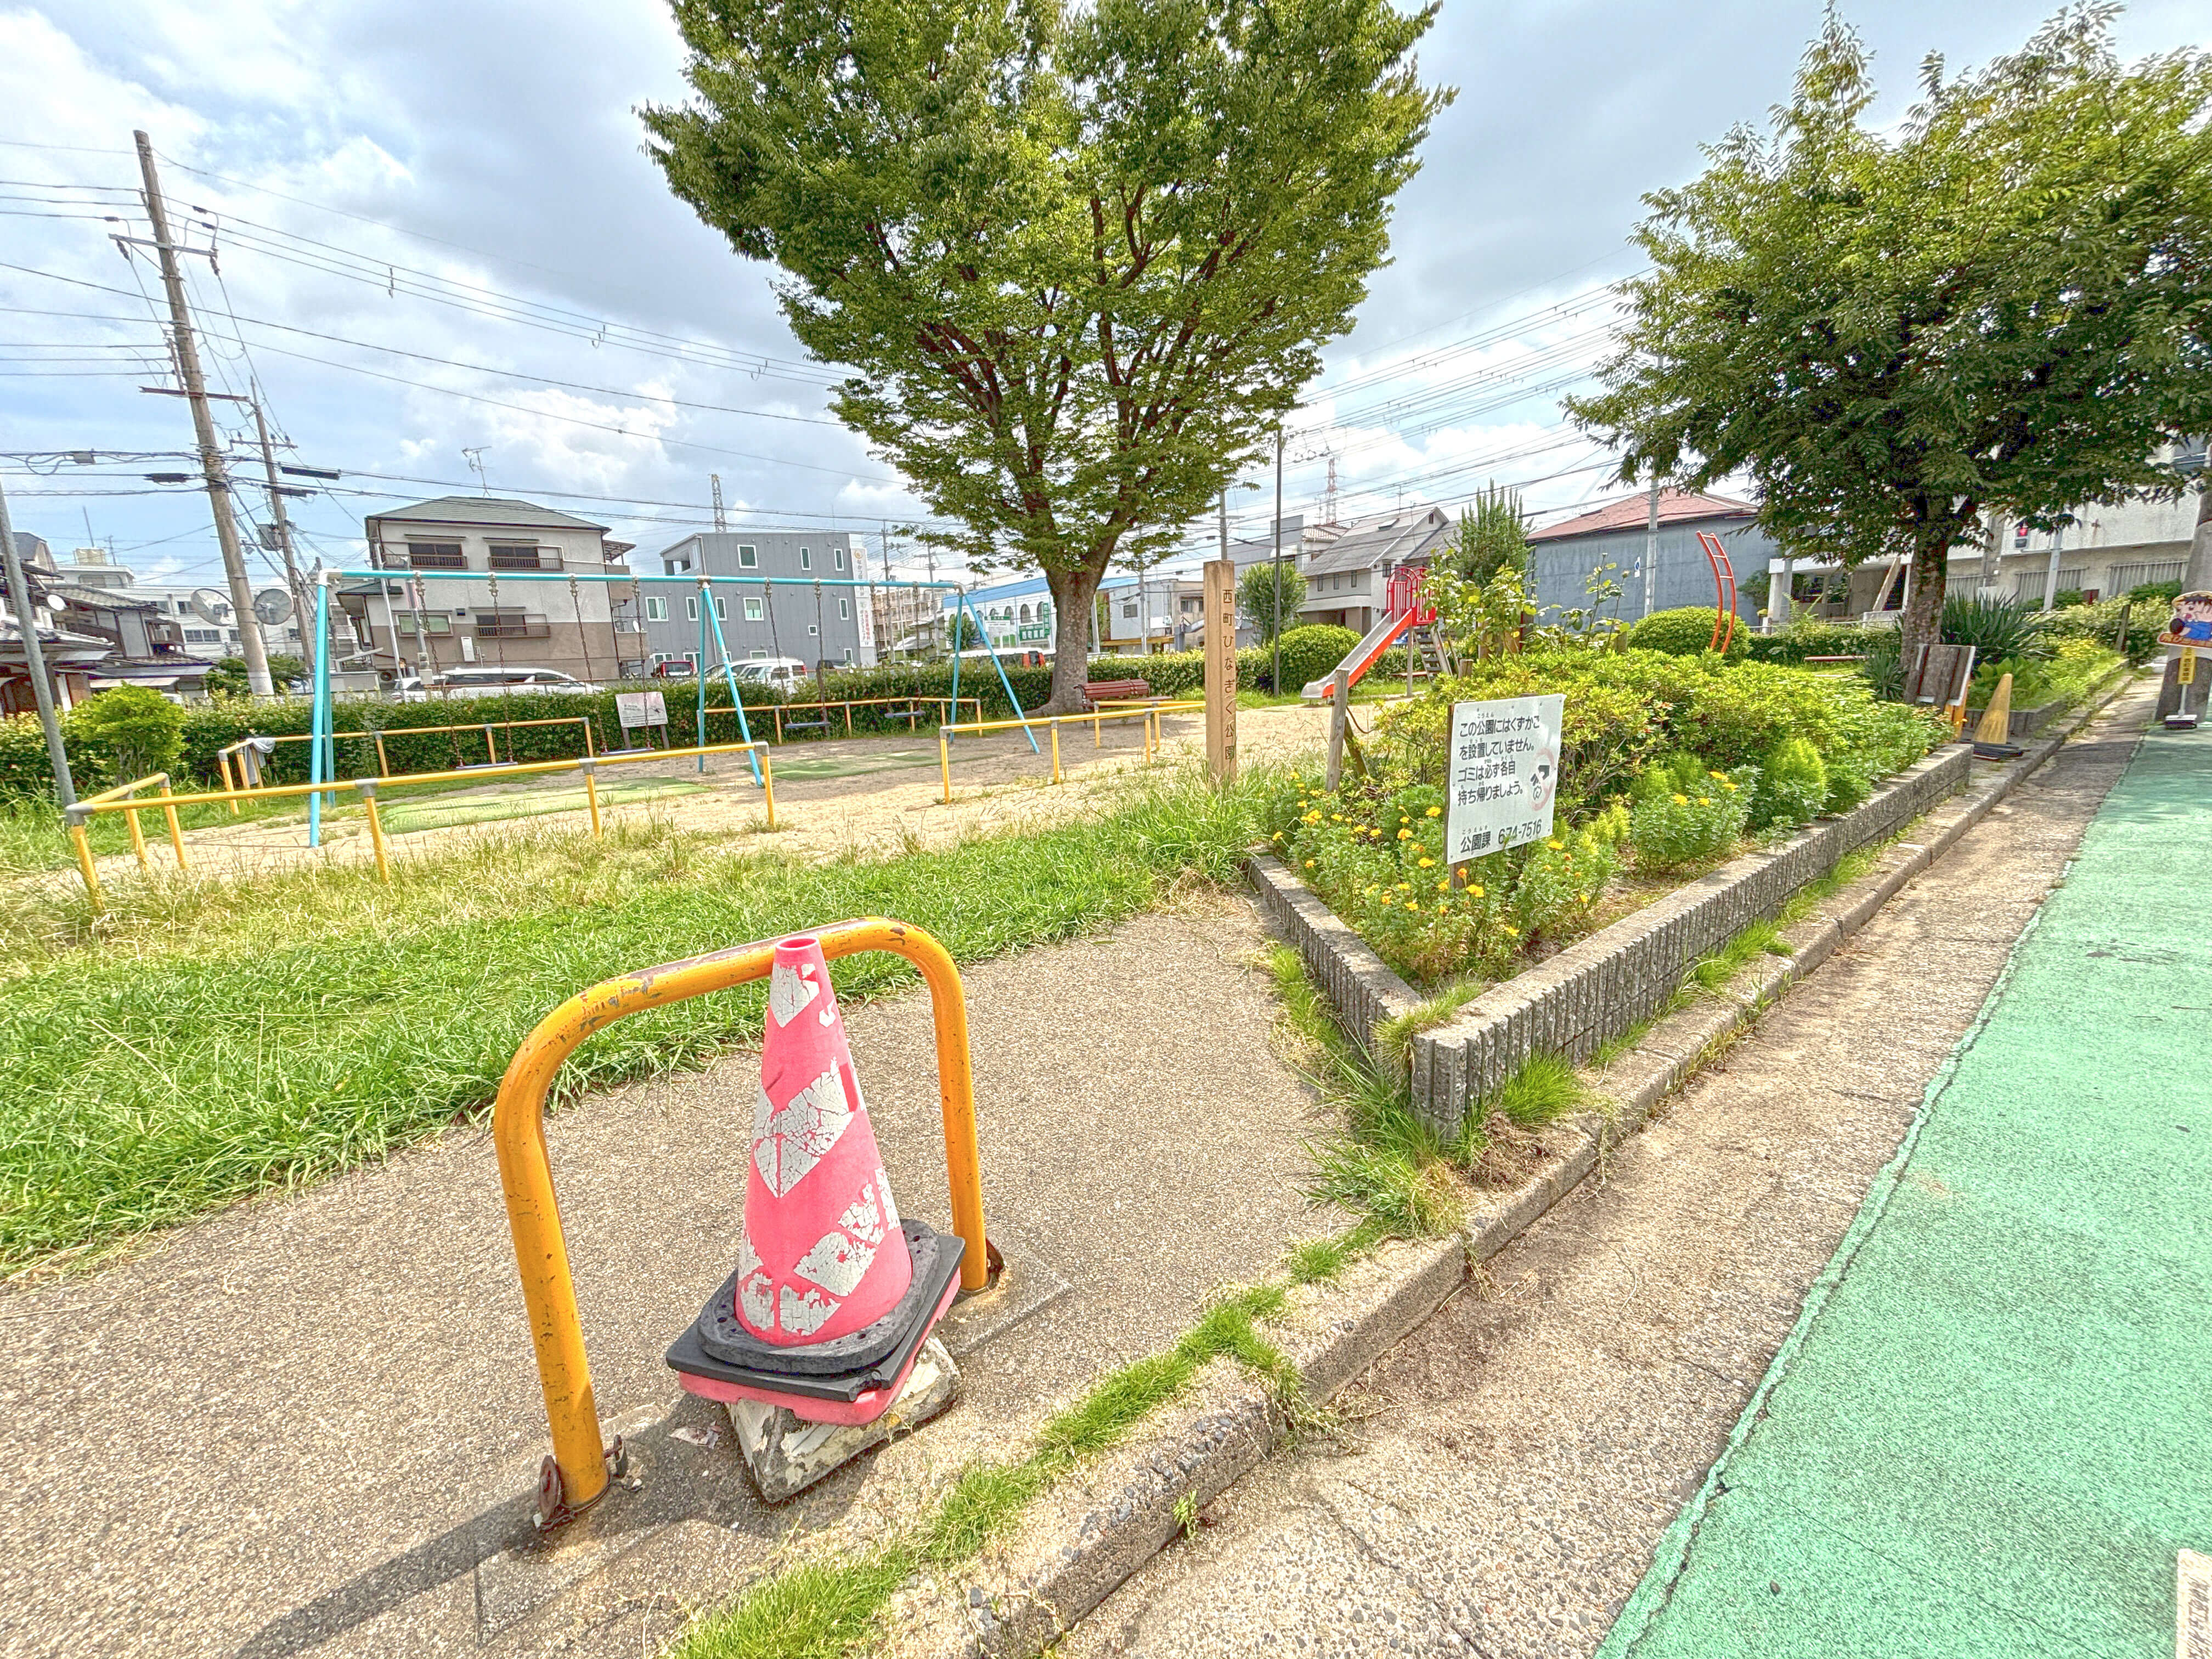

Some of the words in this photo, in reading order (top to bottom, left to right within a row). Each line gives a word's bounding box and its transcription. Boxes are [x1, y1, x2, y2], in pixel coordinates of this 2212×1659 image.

[1222, 589, 1235, 760] 西町ひなぎく公園
[1460, 715, 1539, 737] この公園にはくずかご
[1459, 737, 1534, 760] を設置していません。
[1458, 760, 1516, 782] ゴミは必ず各自
[1458, 781, 1523, 806] 持ち帰りましょう。
[1460, 831, 1491, 853] 公園課
